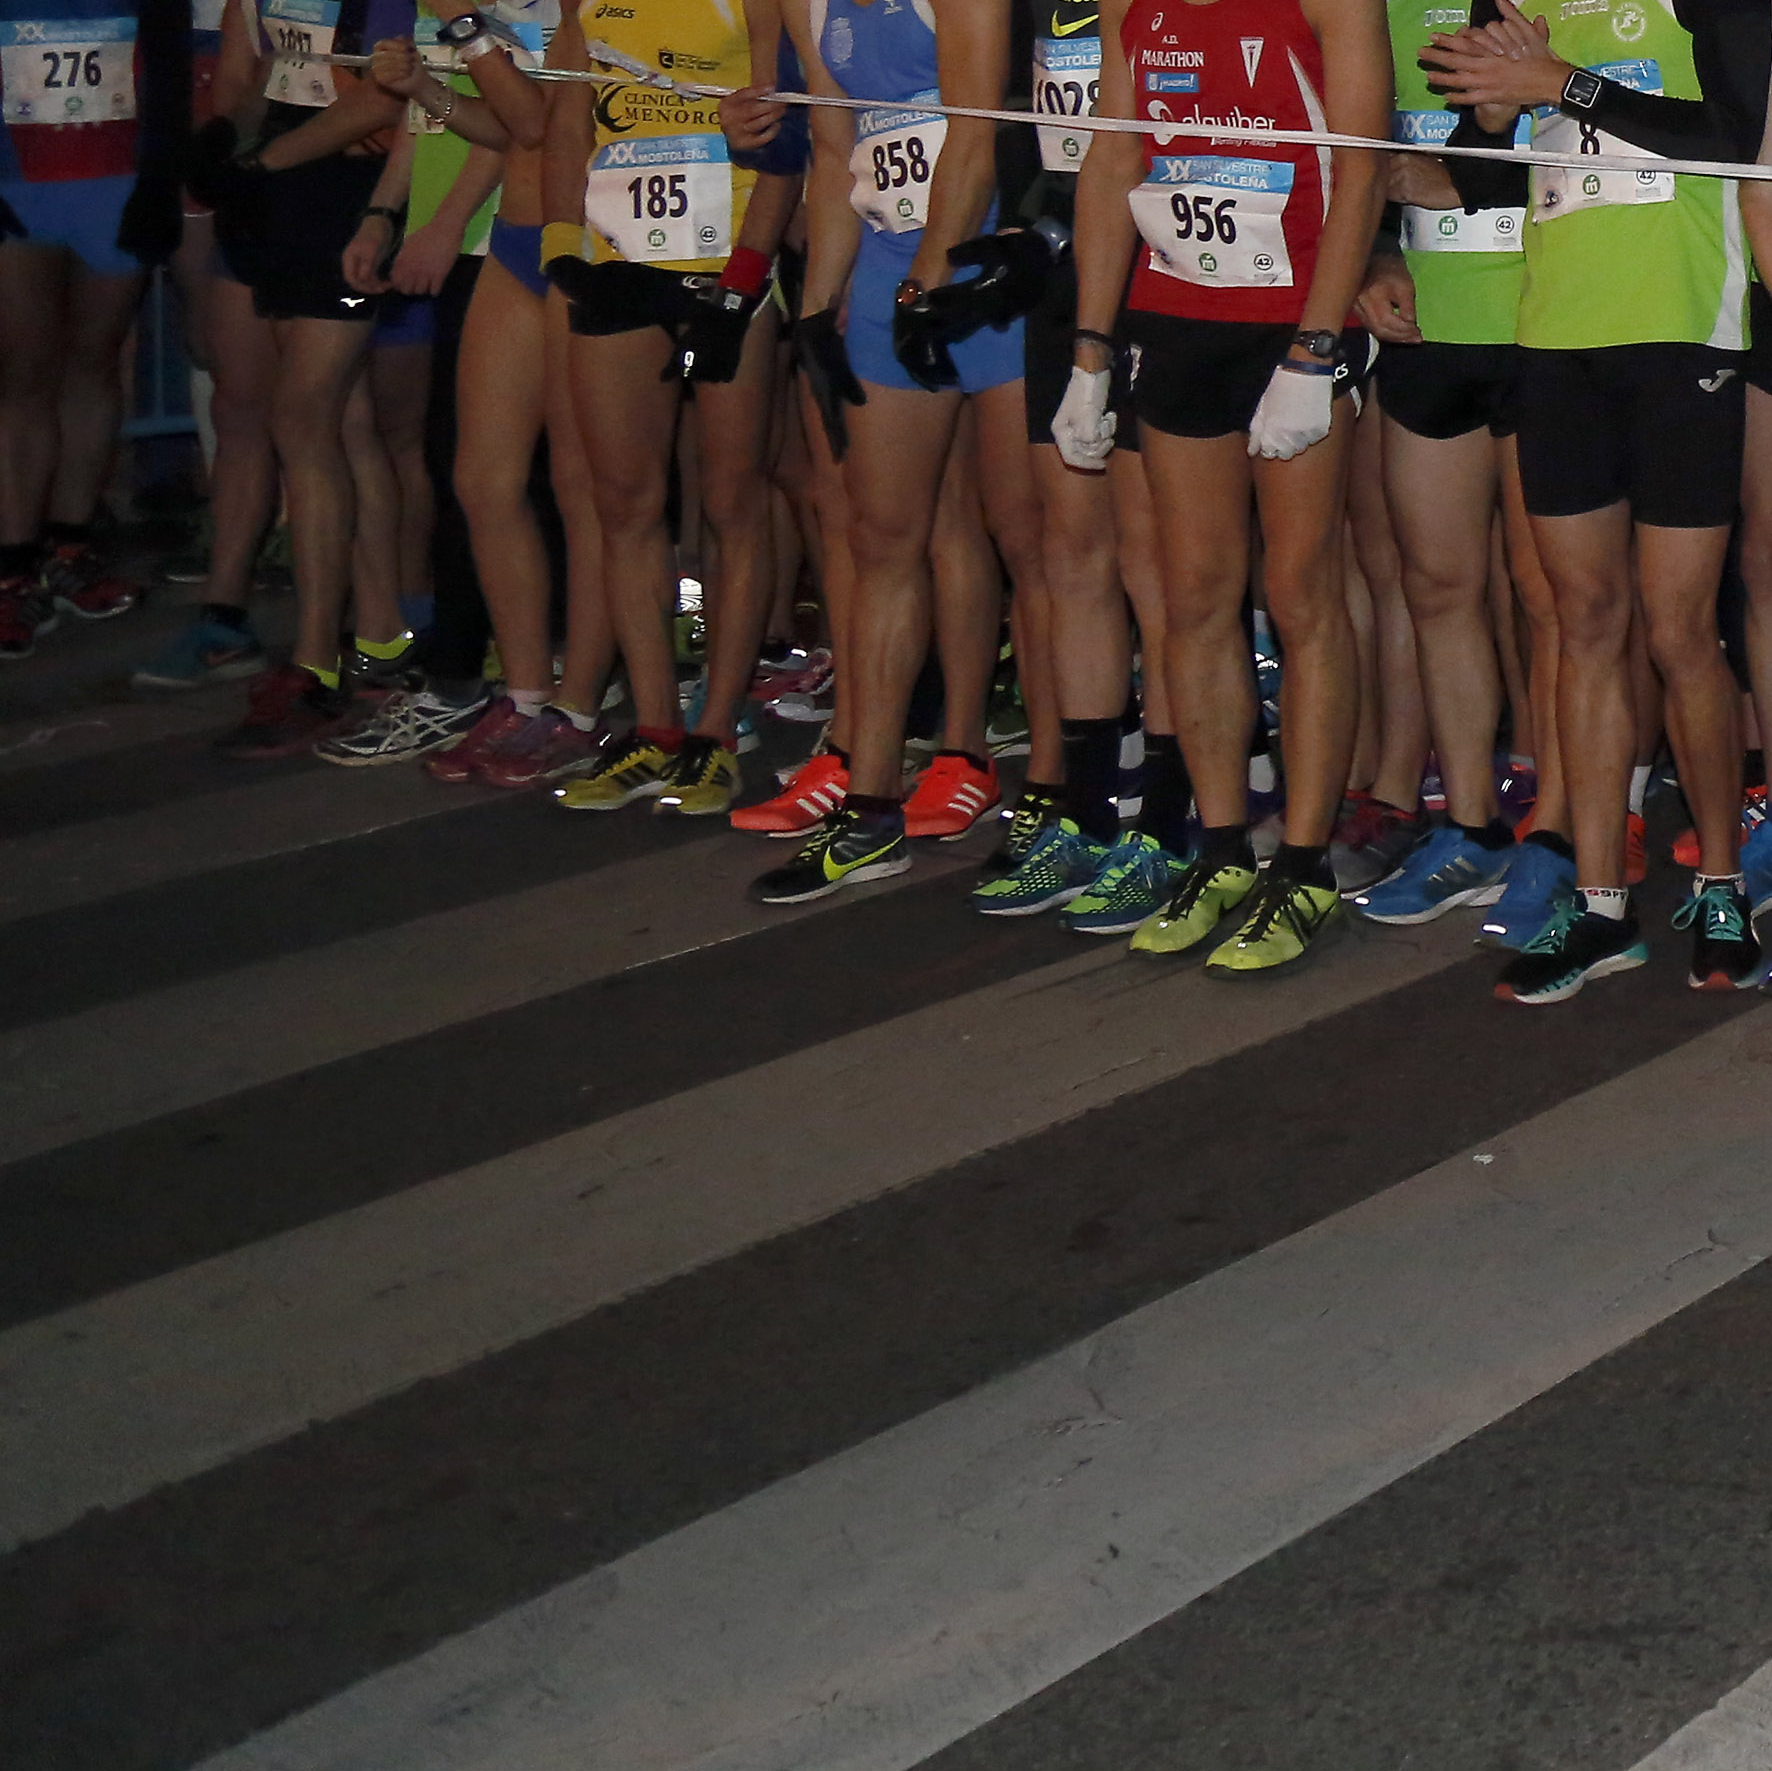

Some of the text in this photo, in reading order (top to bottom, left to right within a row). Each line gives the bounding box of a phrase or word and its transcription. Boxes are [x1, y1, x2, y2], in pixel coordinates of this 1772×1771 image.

[43, 50, 102, 89] 276
[1141, 50, 1205, 67] MARATHON
[625, 93, 686, 106] CLINICA
[625, 108, 720, 124] MENORC
[1401, 115, 1426, 139] XX
[1427, 115, 1450, 126] SAN
[873, 136, 929, 192] 858
[1160, 160, 1192, 181] XX
[627, 175, 688, 220] 185
[1171, 193, 1237, 244] 956
[1498, 221, 1512, 229] 42
